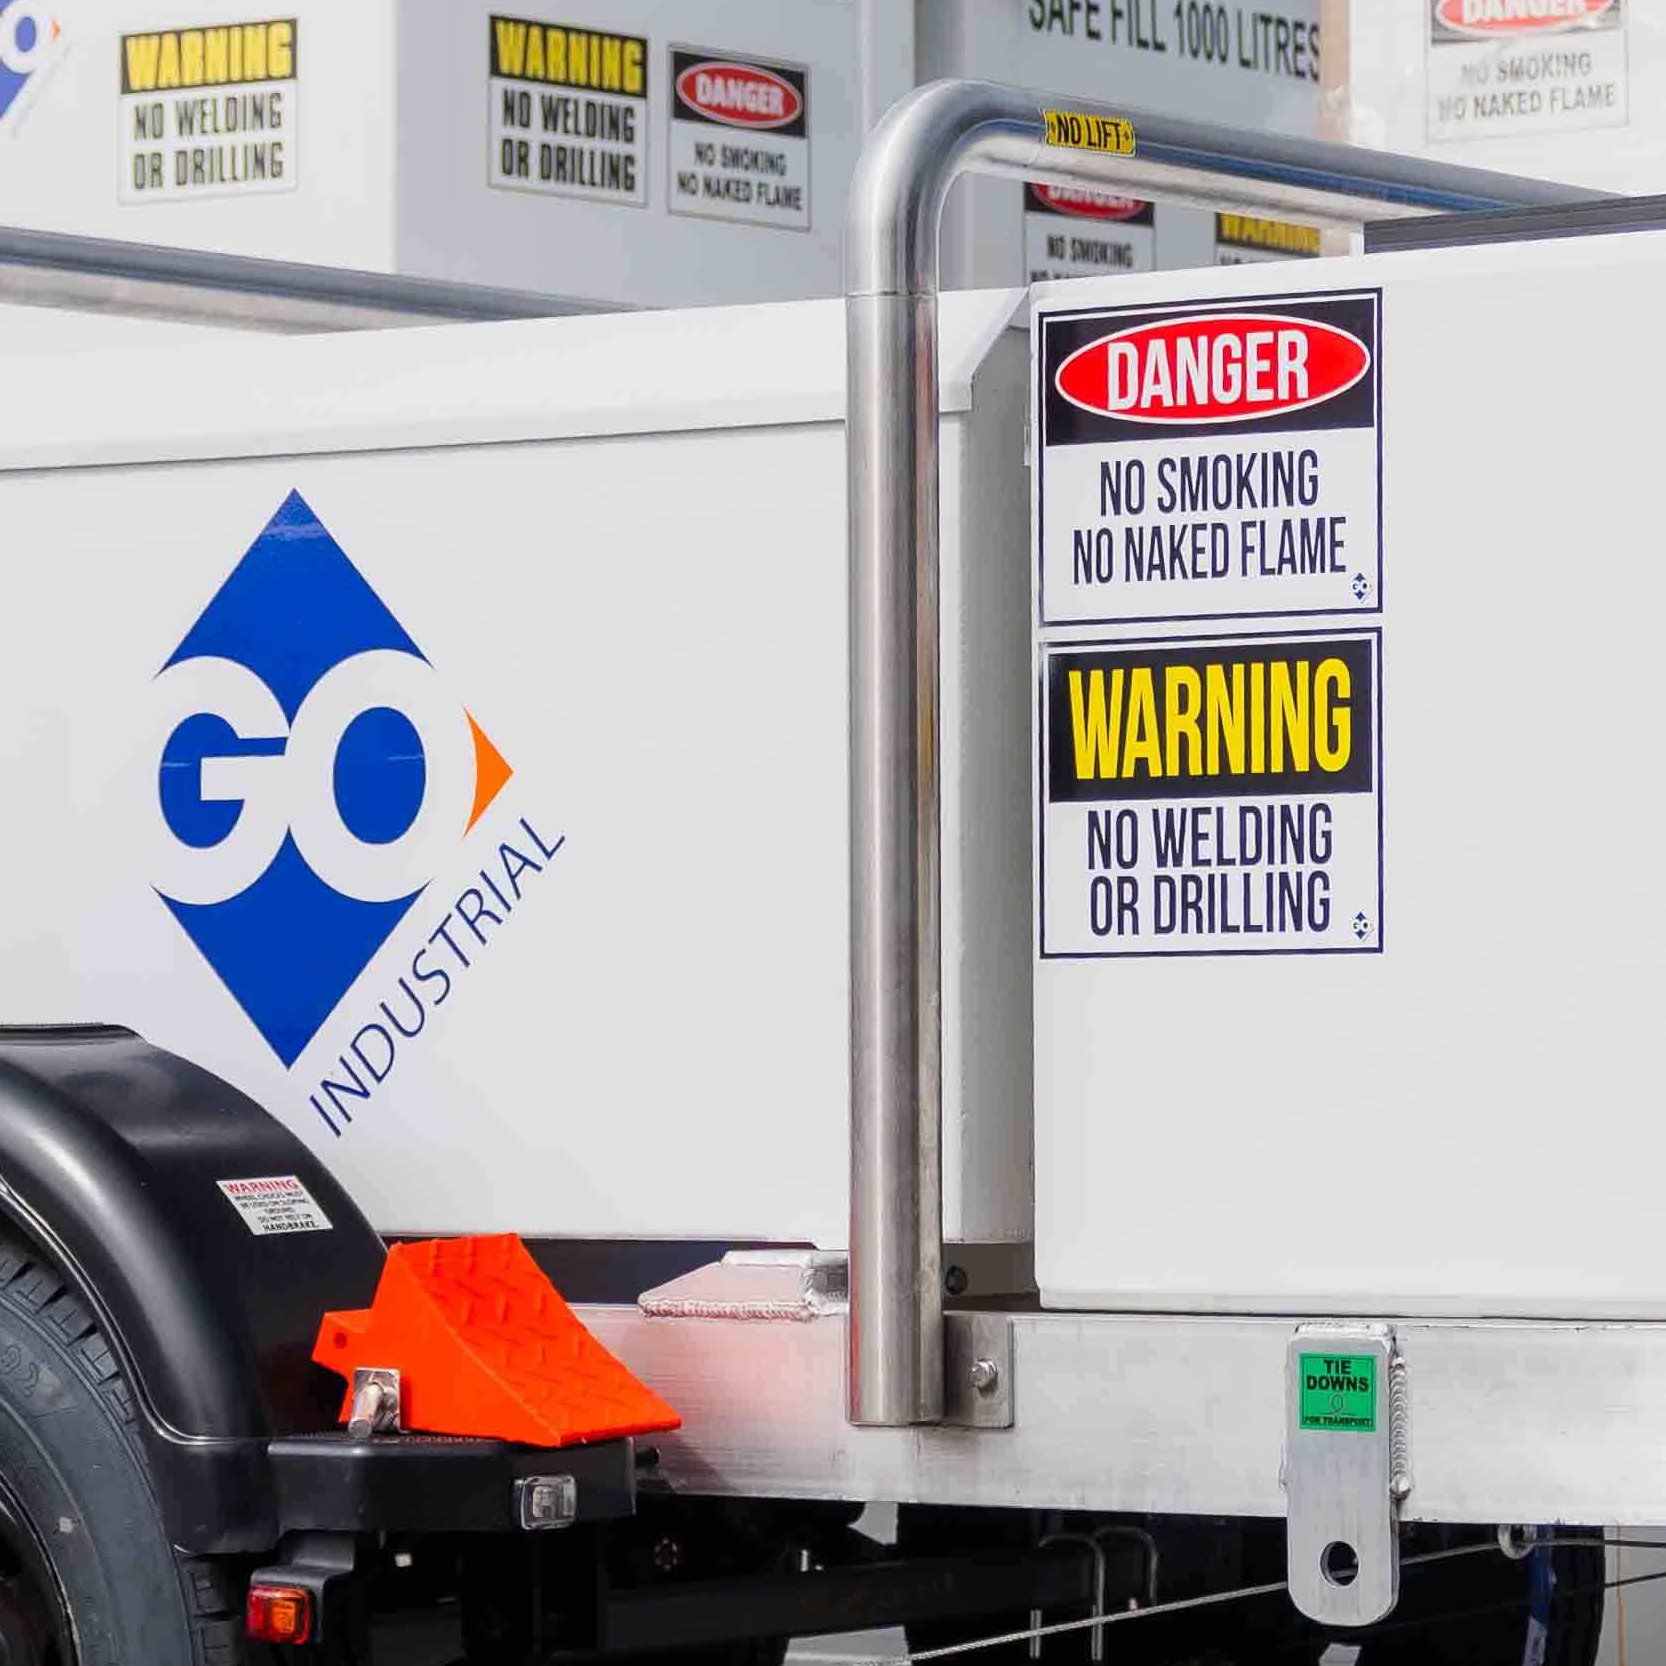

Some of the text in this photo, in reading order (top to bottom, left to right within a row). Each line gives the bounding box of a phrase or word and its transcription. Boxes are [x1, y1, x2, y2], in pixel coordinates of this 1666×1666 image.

[125, 21, 293, 91] WARNING
[495, 20, 645, 94] WARNING
[1238, 8, 1320, 82] LITRES
[1496, 52, 1592, 83] SMOKING
[135, 92, 283, 141] NO WELDING
[503, 88, 635, 144] NO WELDING
[695, 72, 784, 118] DANGER
[1473, 90, 1541, 118] NAKED
[1550, 84, 1614, 113] FLAME
[695, 142, 786, 177] NO SMOKING
[1057, 114, 1123, 150] NO LIFT
[133, 142, 284, 191] OR DRILLING
[502, 139, 635, 193] OR DRILLING
[677, 171, 802, 211] NO NAKED FLAME
[1107, 330, 1309, 412] DANGER
[1100, 449, 1319, 517] NO SMOKING
[1073, 517, 1347, 585] NO NAKED FLAME
[1069, 658, 1351, 780] WARNING
[1087, 802, 1332, 870] NO WELDING
[1090, 871, 1331, 936] OR DRILLING
[310, 817, 566, 1136] INDUSTRIAL
[1306, 1375, 1369, 1392] DOWNS
[1323, 1359, 1352, 1375] TIE
